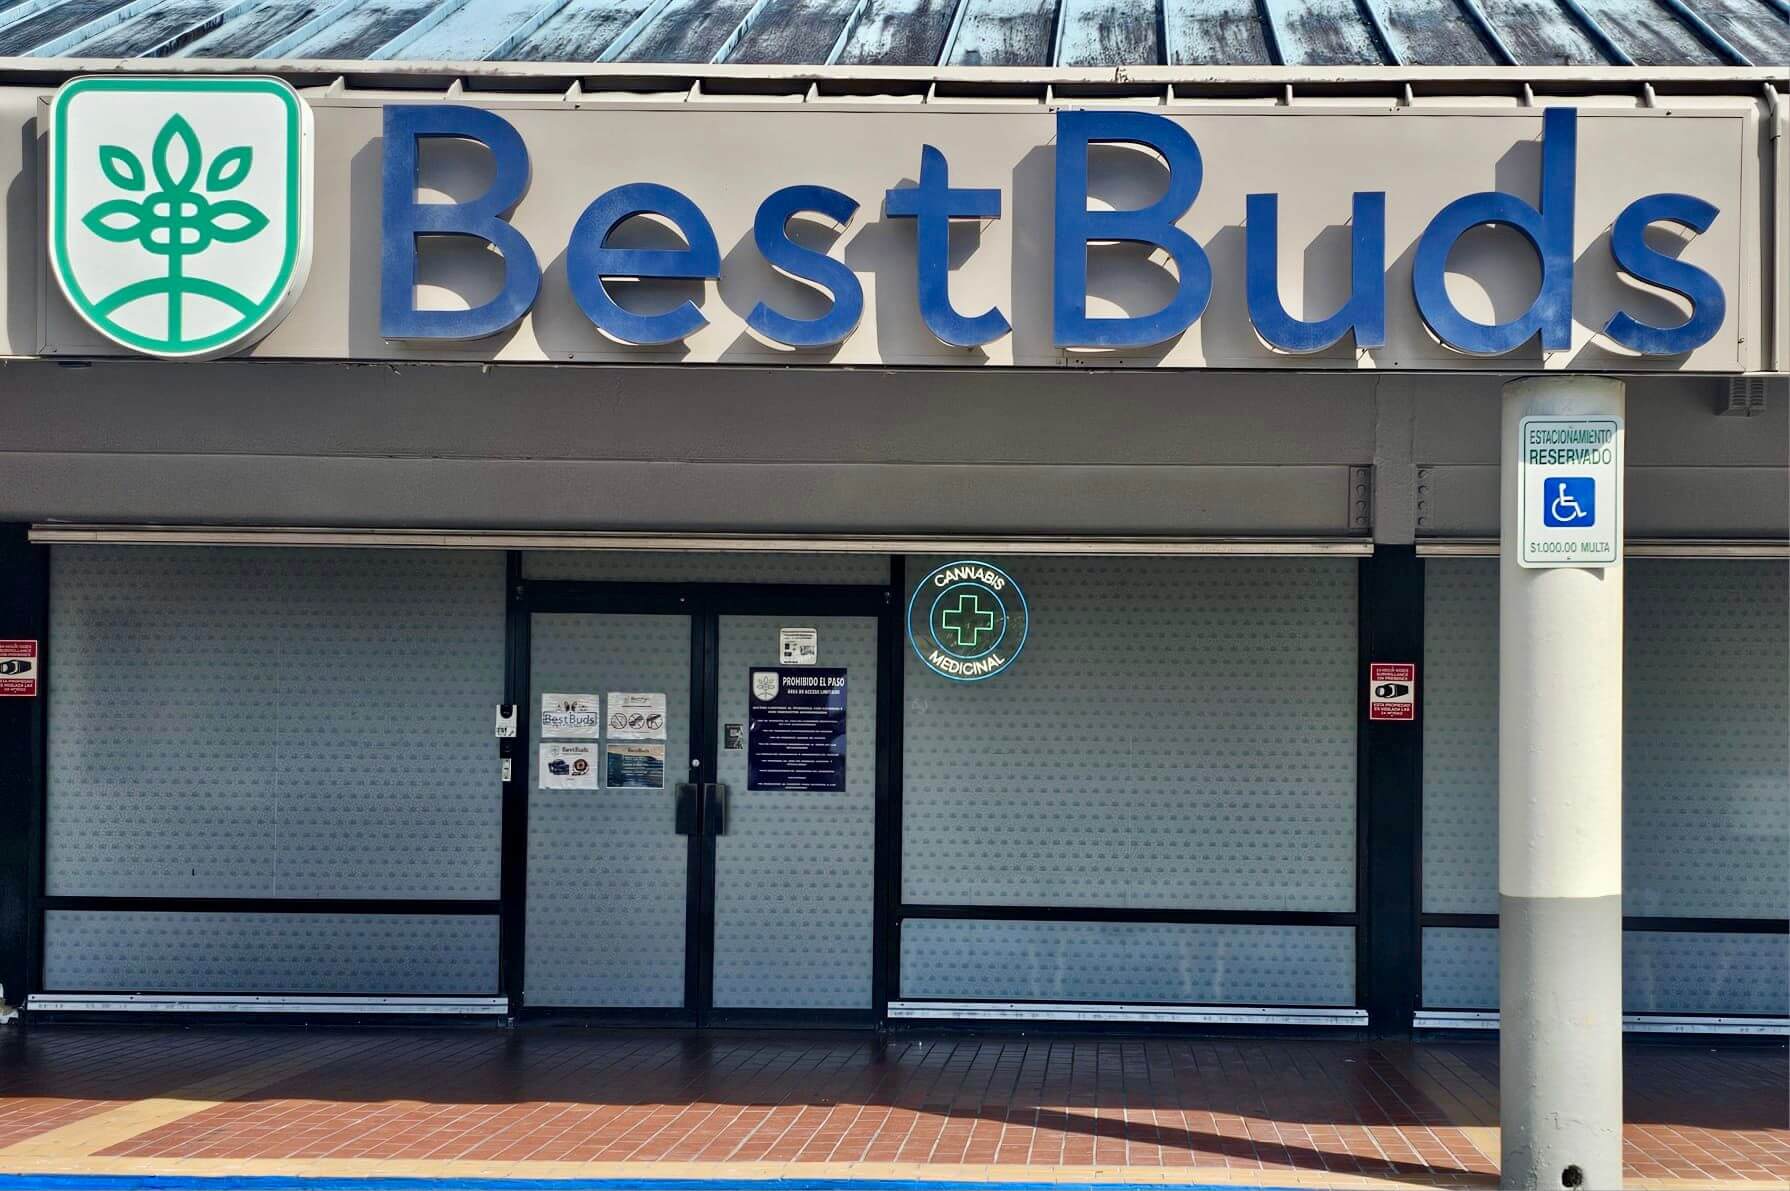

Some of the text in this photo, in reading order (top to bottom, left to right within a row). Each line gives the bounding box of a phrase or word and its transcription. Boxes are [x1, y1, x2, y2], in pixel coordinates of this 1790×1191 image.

[1529, 429, 1612, 445] ESTACIONAMIENTO
[1529, 448, 1612, 465] RESERVADO
[1580, 541, 1611, 553] MULTA
[934, 566, 1006, 590] CANNABIS
[928, 650, 1006, 676] MEDICINAL
[782, 676, 845, 688] PROHIBIDO EL PASO
